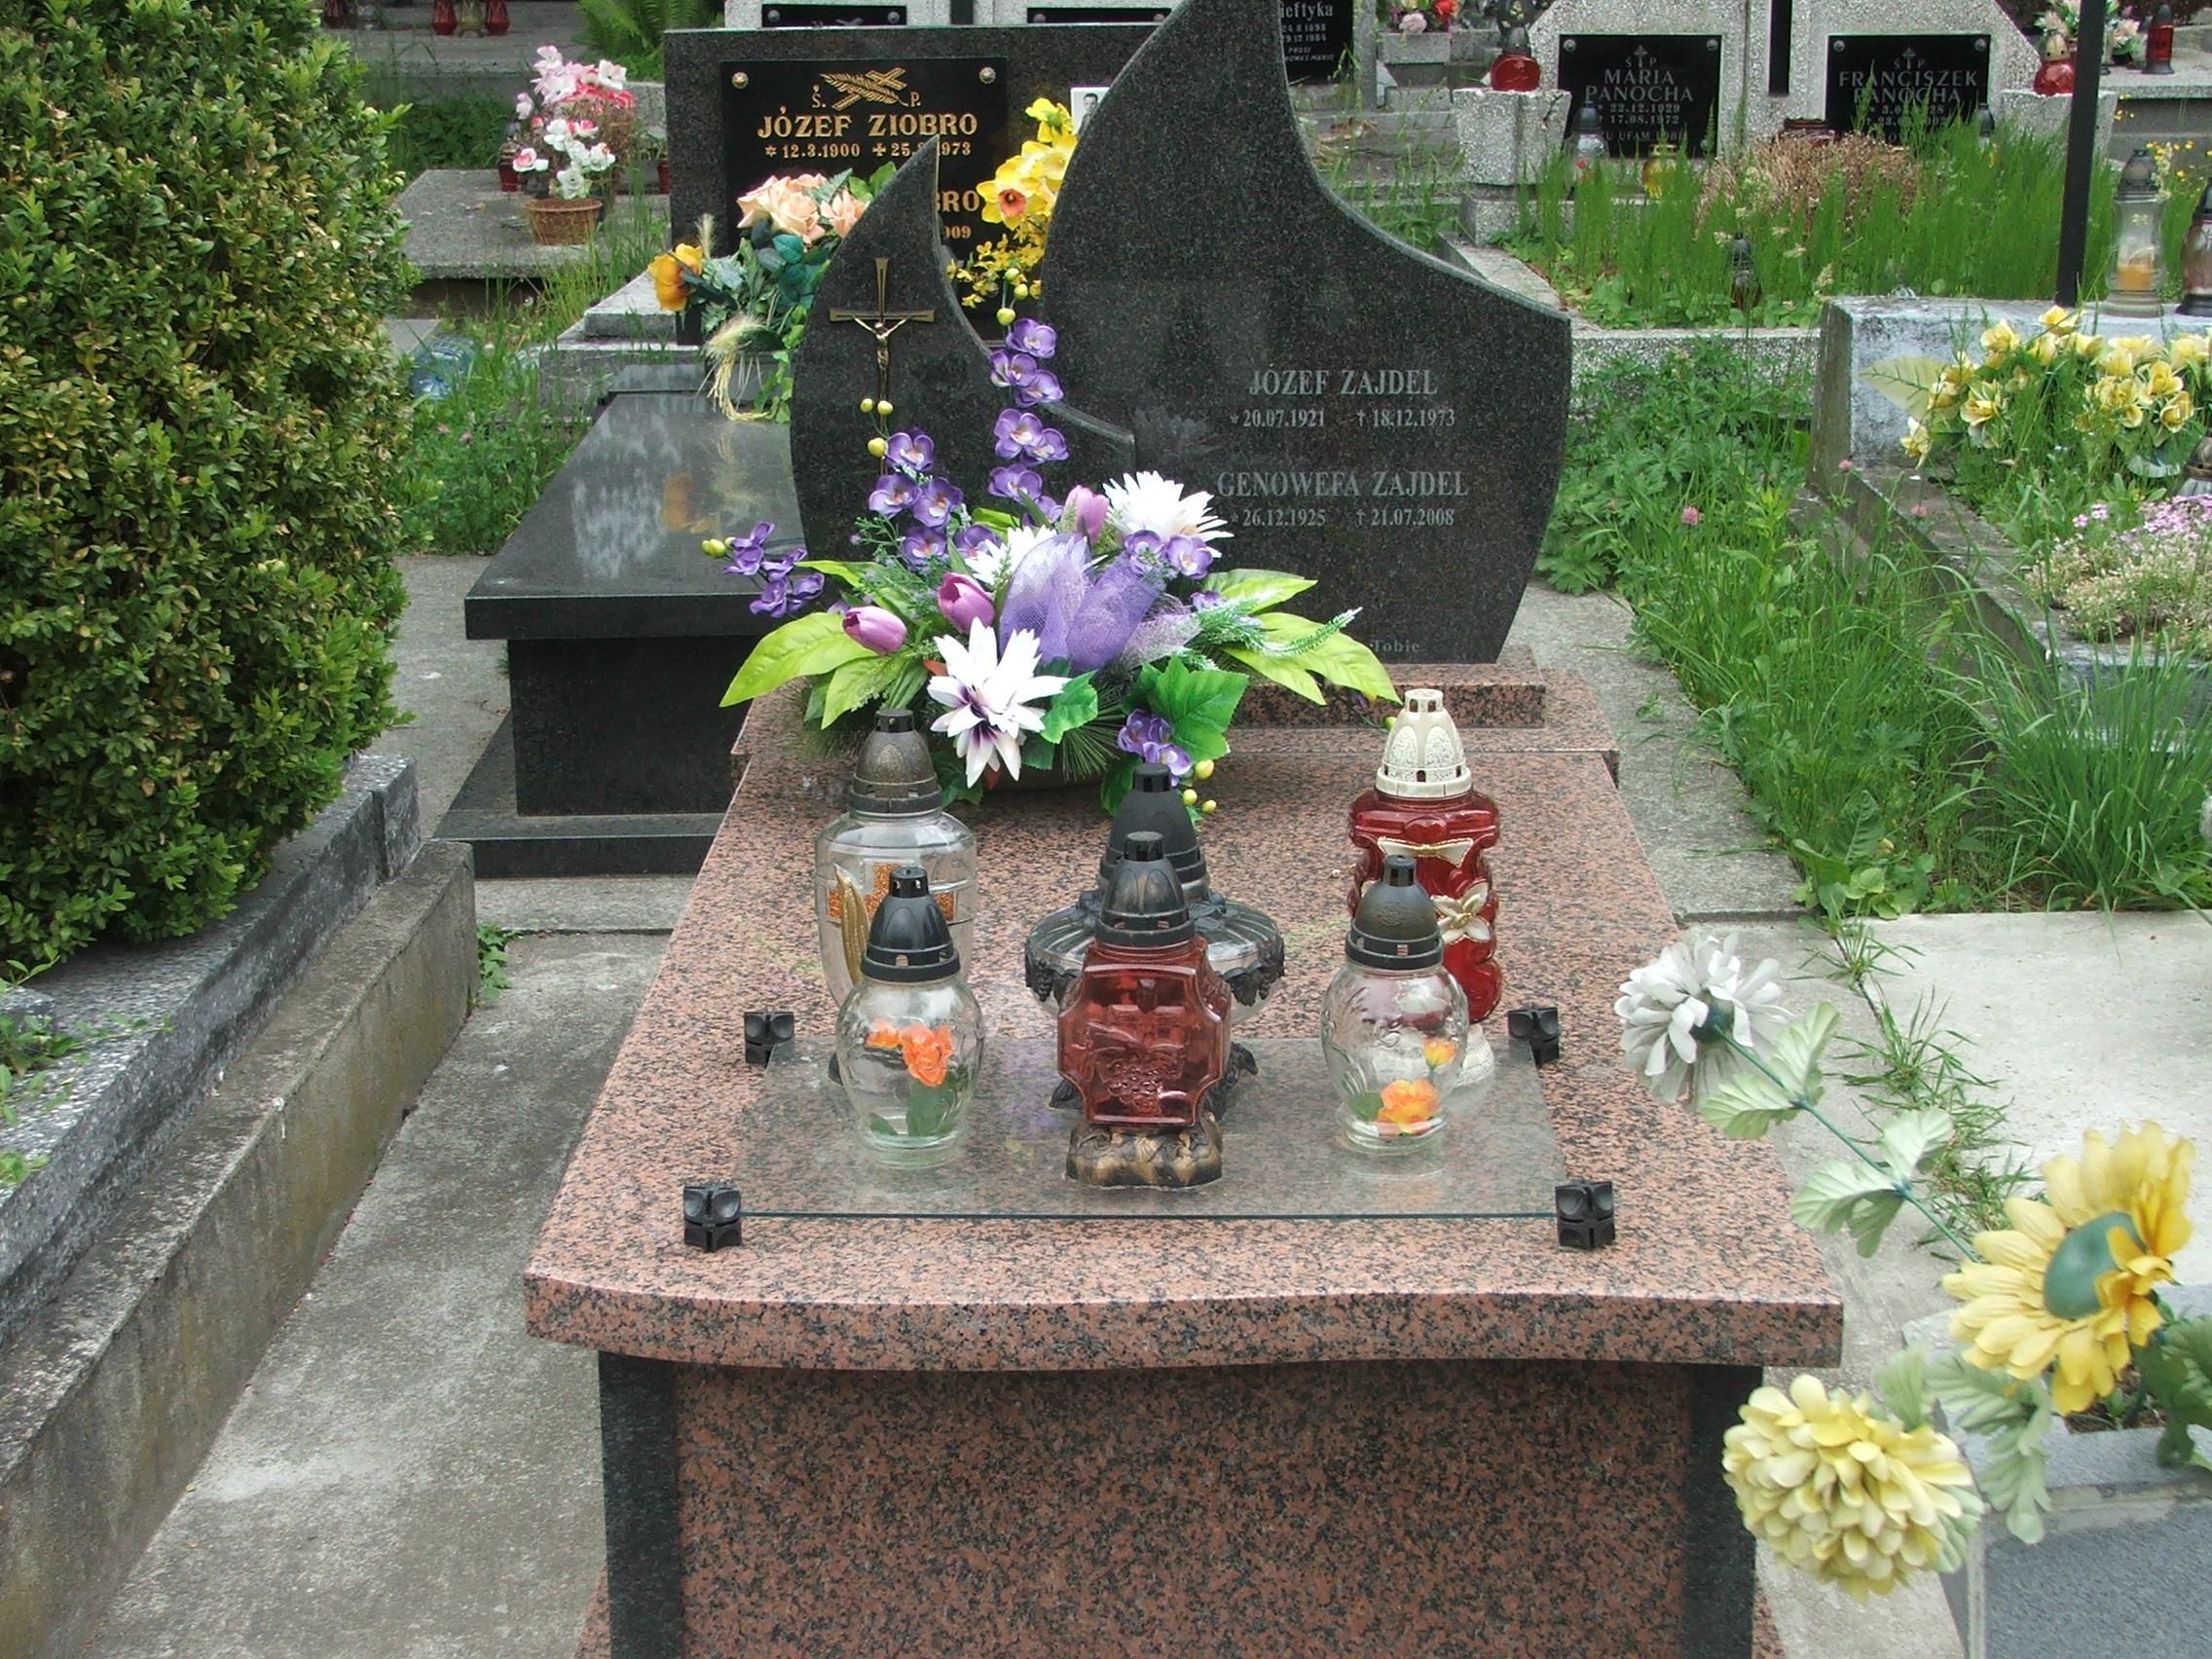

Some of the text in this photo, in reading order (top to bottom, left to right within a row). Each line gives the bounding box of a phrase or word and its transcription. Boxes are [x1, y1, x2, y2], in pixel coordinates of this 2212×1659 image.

[1604, 69, 1675, 85] MARIA
[1585, 86, 1694, 102] PANOCHA
[757, 106, 978, 138] JÓZEF ZIOBRO
[783, 144, 861, 159] 12.3.1900
[1340, 369, 1438, 396] ZAJDEL
[1242, 408, 1456, 427] 20.07.1921 18.12.1973
[1217, 471, 1470, 498] GENOWEFA ZAJDEL
[1242, 508, 1455, 527] 26.12.1925 21.07.2008
